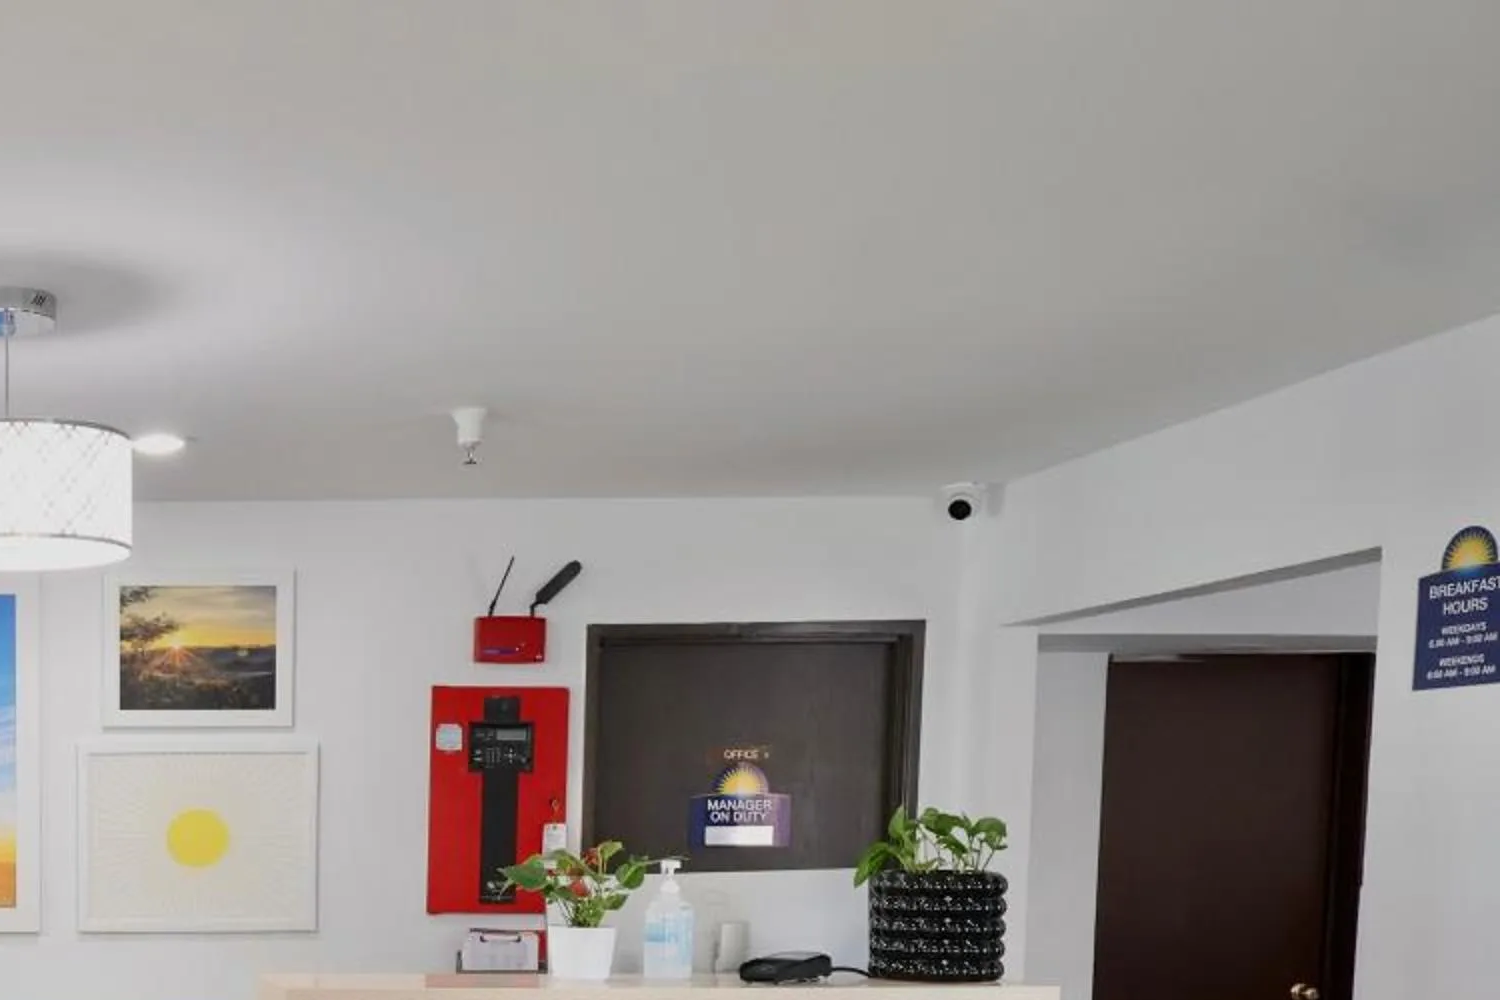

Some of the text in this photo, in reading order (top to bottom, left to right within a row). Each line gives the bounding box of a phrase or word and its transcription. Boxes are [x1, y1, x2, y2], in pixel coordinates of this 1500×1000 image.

[1443, 598, 1489, 615] HOURS
[1441, 622, 1487, 636] WEEKDAYS
[1445, 637, 1460, 647] AM
[1484, 631, 1499, 642] AM
[1438, 654, 1485, 667] WEEKENDS
[1482, 665, 1497, 675] AM
[723, 749, 759, 759] OFFICE
[707, 799, 773, 811] MANAGER
[709, 811, 767, 823] ON DUTY
